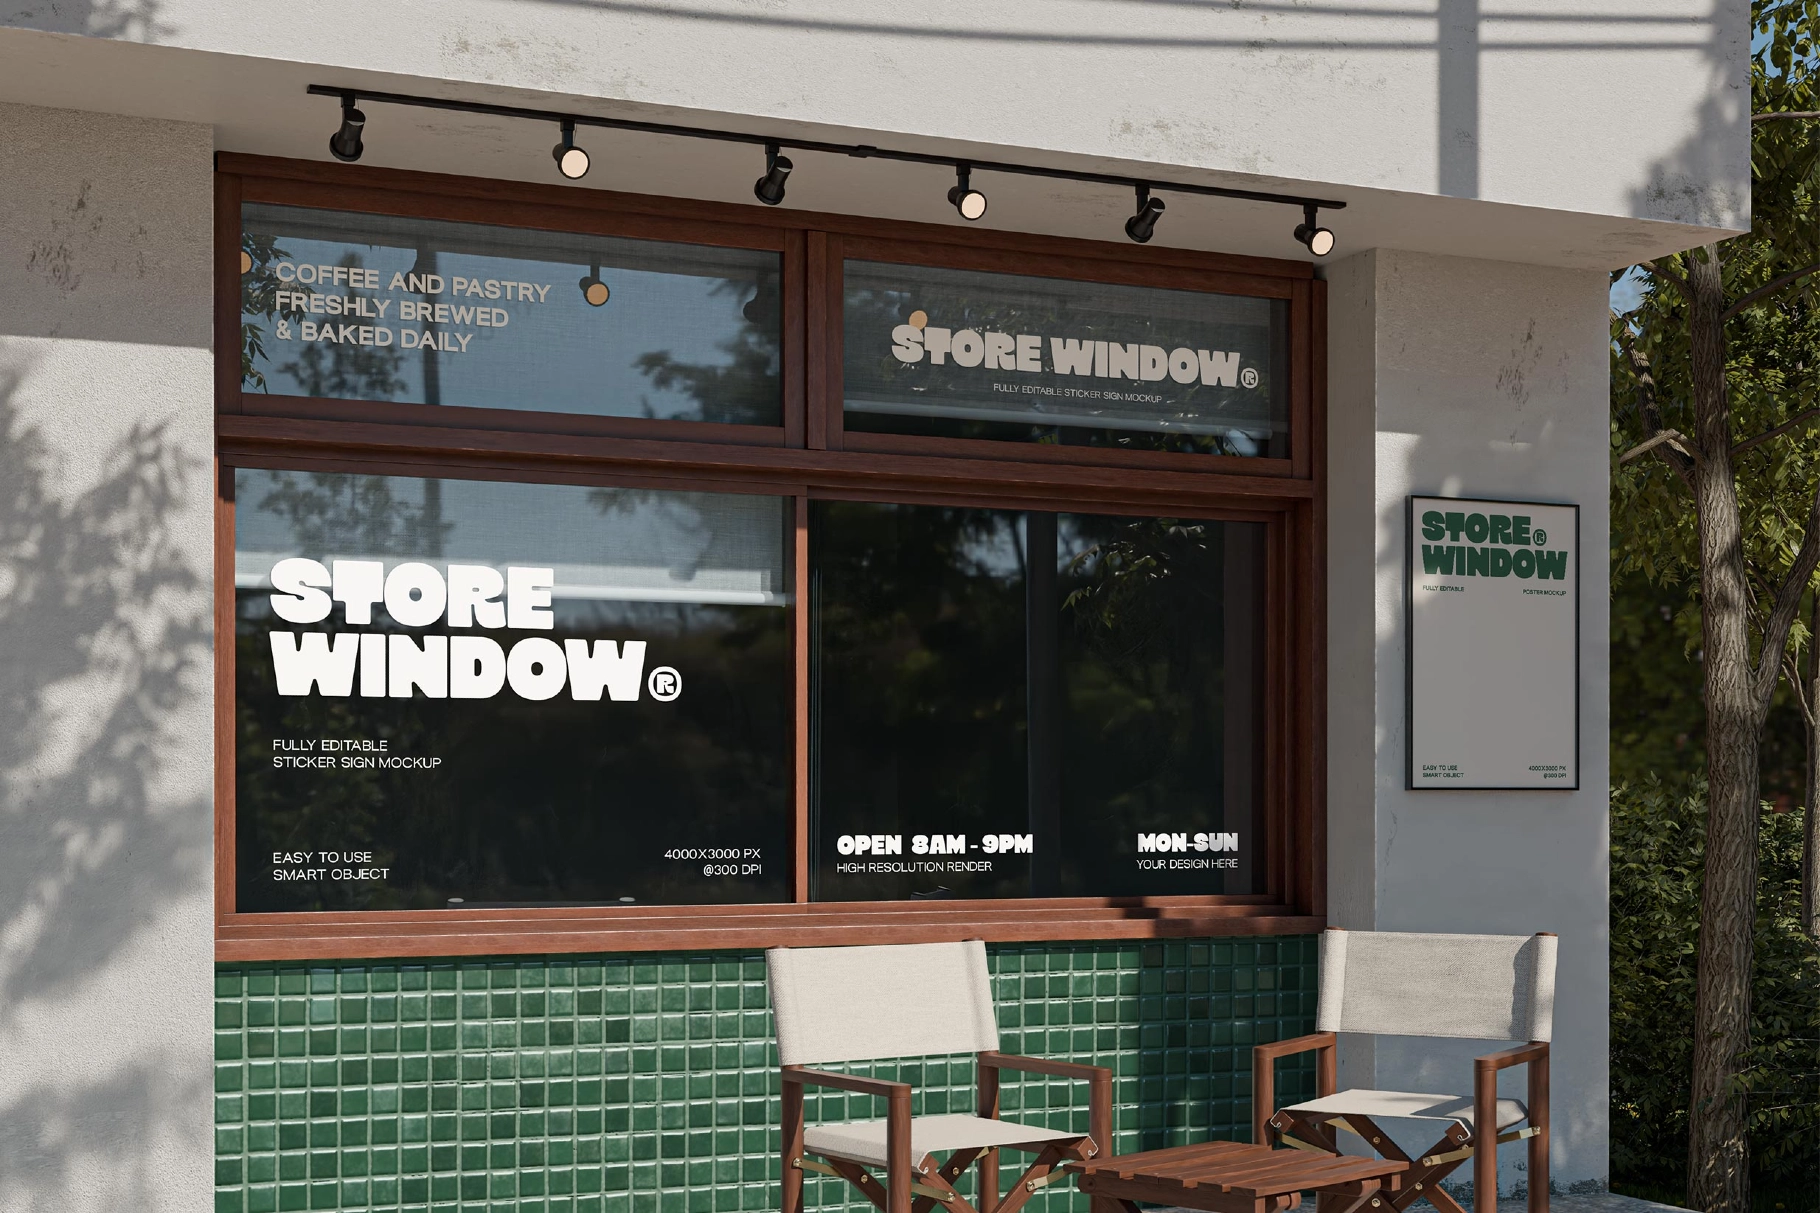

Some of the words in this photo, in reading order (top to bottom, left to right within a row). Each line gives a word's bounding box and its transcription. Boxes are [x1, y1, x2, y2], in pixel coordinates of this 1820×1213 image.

[275, 261, 380, 289] COFFEE
[388, 271, 445, 294] AND
[452, 276, 551, 303] PASTRY
[275, 291, 392, 319] FRESHLY
[400, 301, 509, 328] BREWED
[275, 320, 292, 340] &
[301, 322, 393, 347] BAKED
[401, 329, 474, 353] DAILY
[891, 324, 1042, 373] STORE
[993, 383, 1019, 393] FULLY
[1022, 385, 1062, 396] EDITABLE
[1064, 388, 1101, 400] STICKER
[1103, 391, 1124, 401] SIGN
[1125, 393, 1163, 404] MOCKUP
[1421, 544, 1568, 580] WINDOW
[269, 557, 555, 630] STORE
[1422, 584, 1439, 592] FULLY
[1439, 585, 1465, 593] EDITABLE
[1522, 588, 1544, 596] POSTER
[272, 739, 317, 752] FULLY
[321, 739, 388, 752] EDITABLE
[272, 756, 337, 769] STICKER
[340, 756, 376, 769] SIGN
[378, 756, 442, 770] MOCKUP
[836, 834, 903, 855] OPEN
[911, 834, 966, 855] 8AM
[981, 833, 1034, 854] 9PM
[1137, 832, 1239, 853] MON-SUN
[272, 851, 314, 864] EASY
[318, 851, 340, 863] TO
[343, 851, 372, 863] USE
[664, 848, 741, 860] 4000X3000
[743, 848, 761, 859] PX
[703, 864, 738, 877] @300
[741, 863, 762, 875] DPI
[836, 862, 866, 873] HIGH
[868, 861, 944, 873] RESOLUTION
[947, 861, 993, 872] RENDER
[1136, 859, 1167, 870] YOUR
[1169, 858, 1209, 869] DESIGN
[1211, 858, 1239, 869] HERE
[273, 868, 327, 881] SMART
[330, 868, 390, 880] OBJECT
